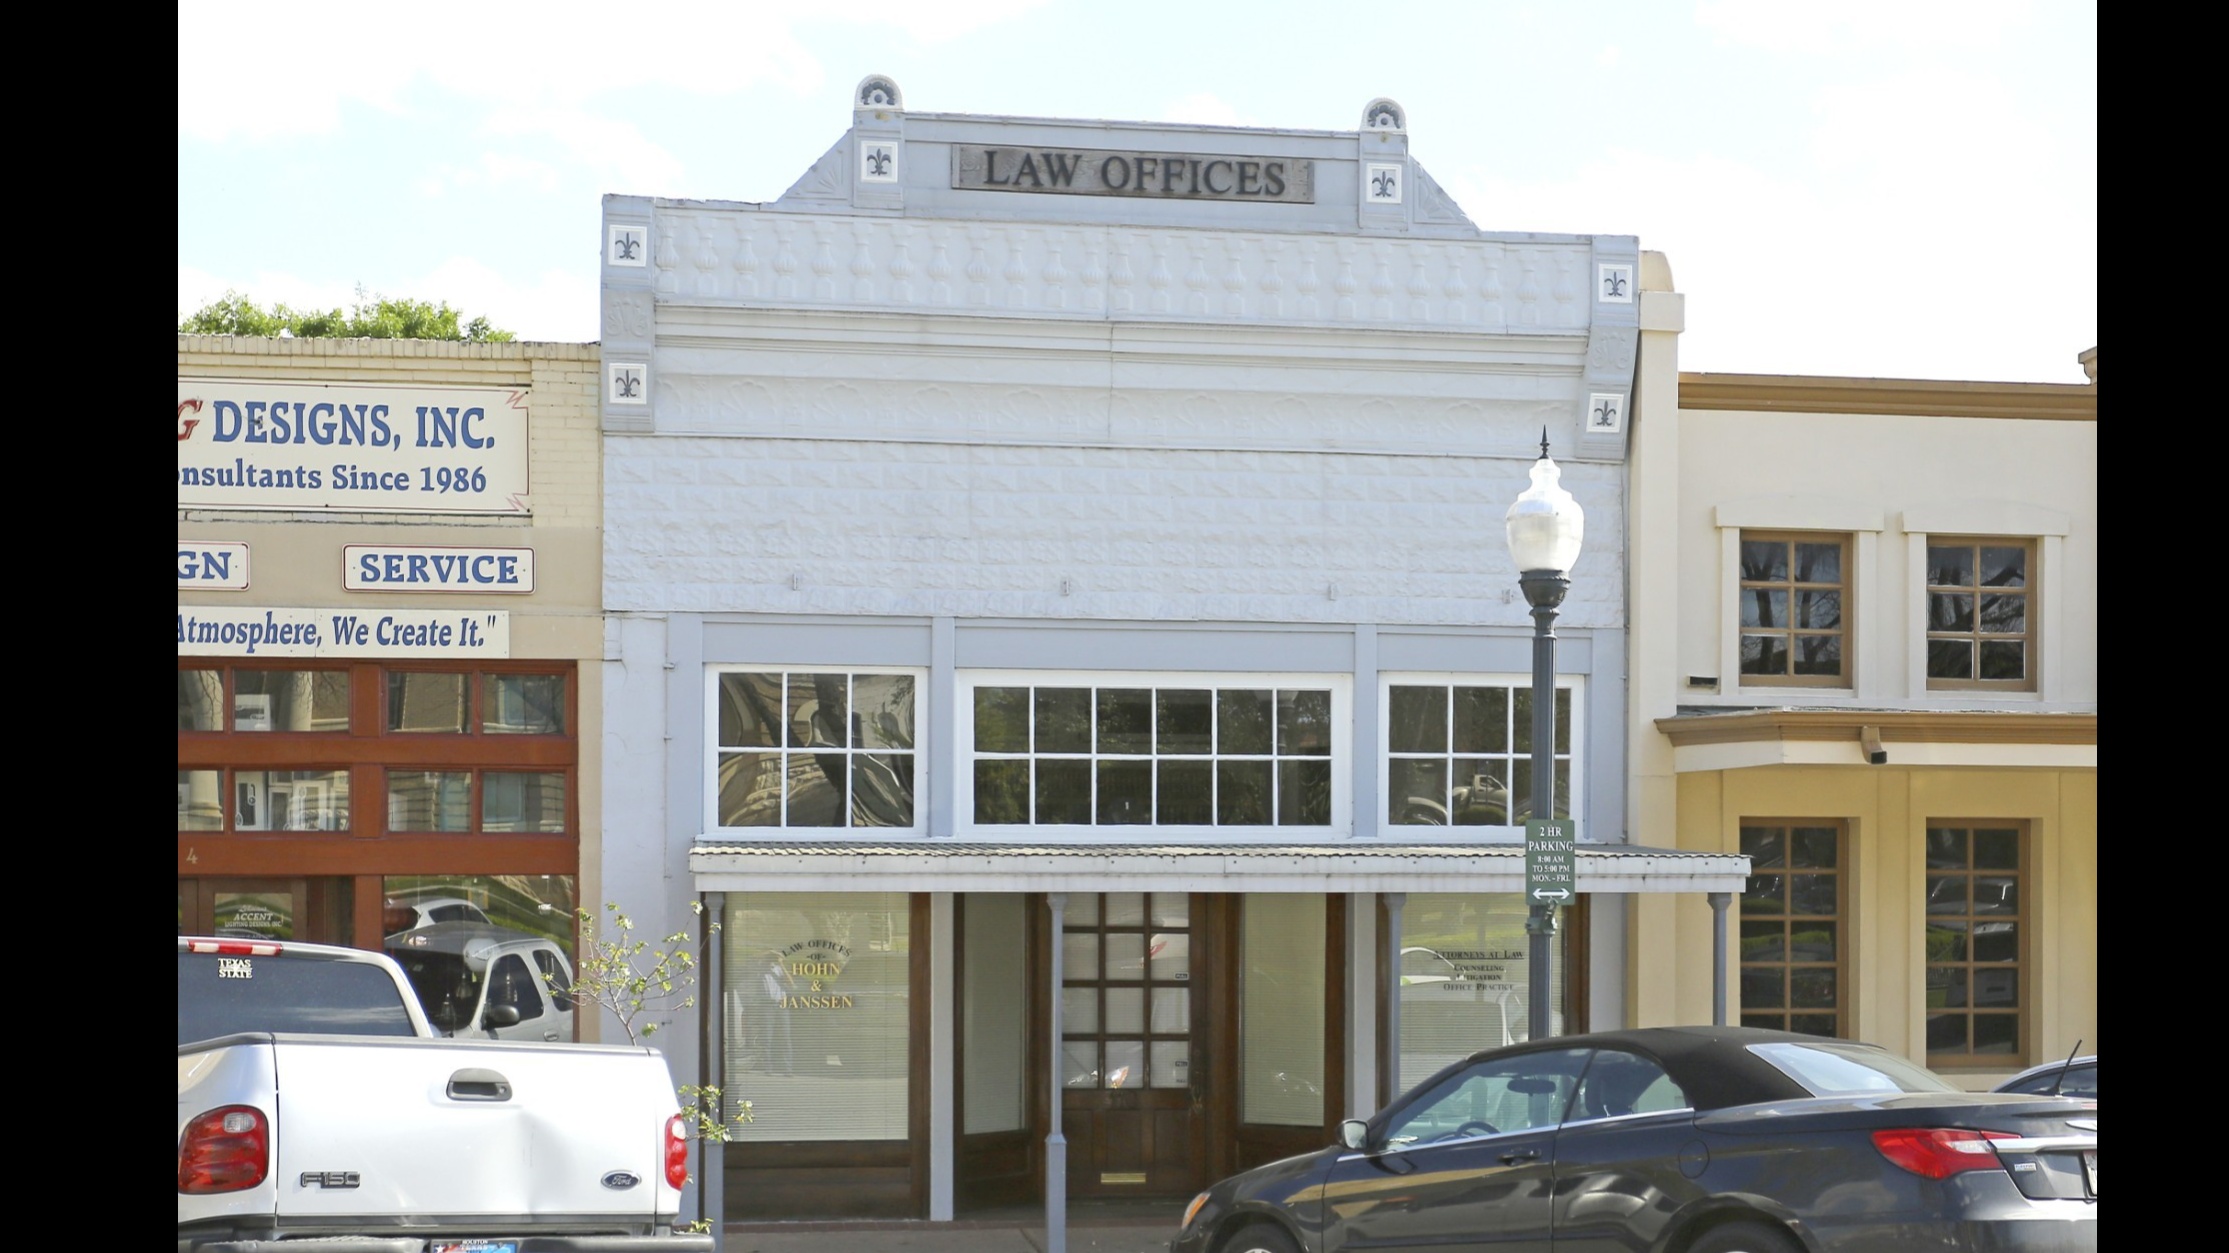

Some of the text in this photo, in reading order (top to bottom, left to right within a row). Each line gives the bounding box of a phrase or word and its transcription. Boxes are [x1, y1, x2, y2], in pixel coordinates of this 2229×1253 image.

[984, 150, 1286, 196] LAW OFFICES
[212, 400, 401, 451] DESIGNS,
[415, 406, 495, 449] INC.
[178, 458, 487, 494] nsultants Since 1986
[360, 554, 519, 584] SERVICE
[331, 615, 369, 646] We
[376, 618, 452, 646] Create
[1540, 826, 1562, 837] 2 HR
[1528, 840, 1574, 852] PARKING
[1537, 855, 1565, 863] 8:00 AM
[1532, 865, 1570, 873] TO 5:00 PM
[1531, 874, 1551, 882] MON.
[233, 913, 274, 921] ACCENT
[781, 939, 853, 958] LAW OFFICES
[1504, 950, 1524, 958] LAW
[218, 958, 251, 967] TEXAS
[219, 969, 253, 978] STATE
[792, 963, 840, 975] HOHN
[811, 980, 821, 992] &
[780, 996, 853, 1008] JANSSEN
